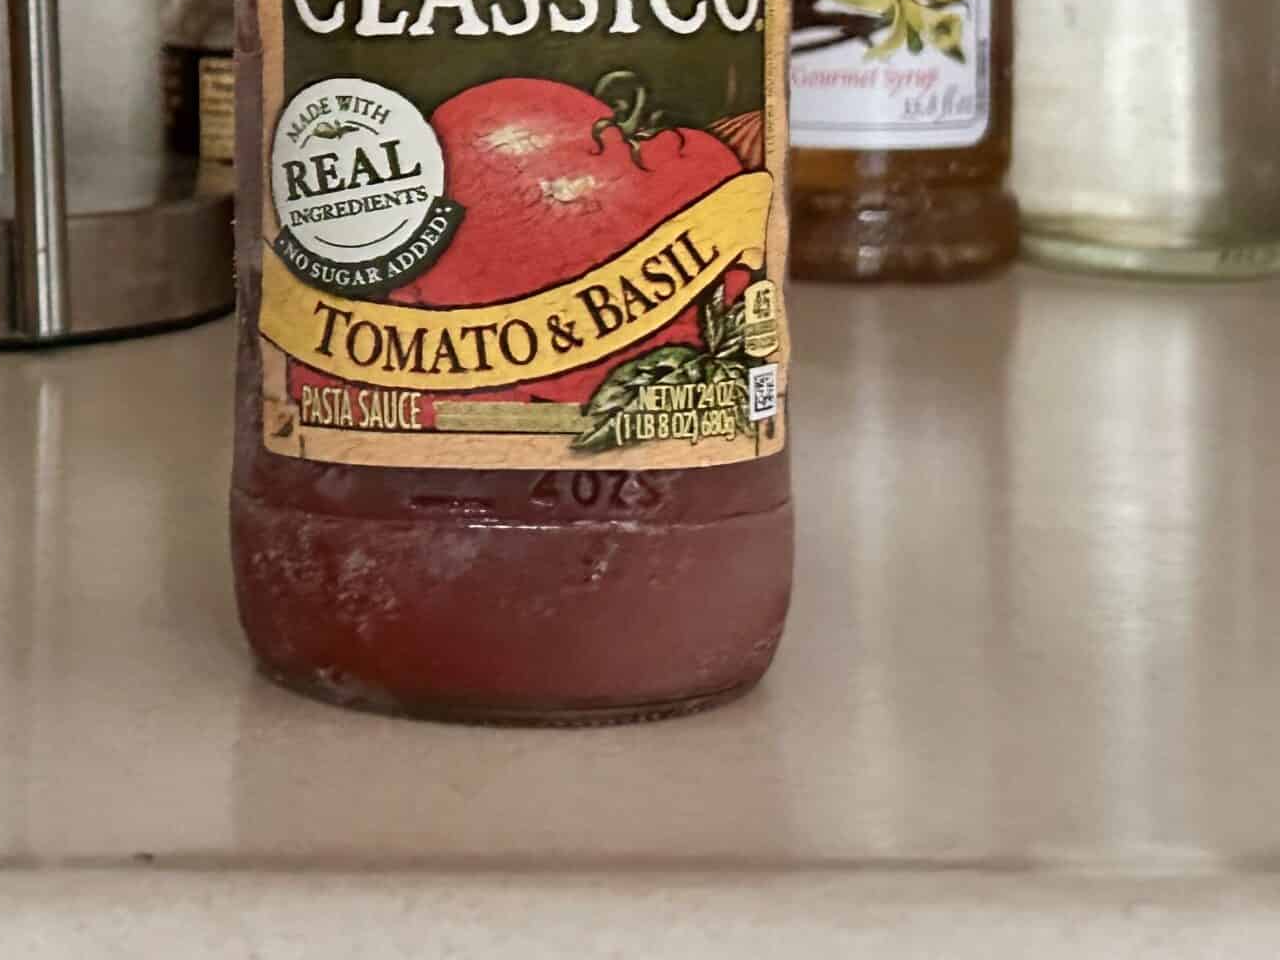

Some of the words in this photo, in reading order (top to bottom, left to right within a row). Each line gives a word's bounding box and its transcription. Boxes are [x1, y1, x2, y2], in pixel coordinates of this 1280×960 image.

[287, 97, 332, 143] MADE
[336, 95, 392, 125] WITH
[282, 139, 422, 201] REAL
[289, 185, 429, 227] INGREDIENTS
[284, 246, 309, 271] NO
[311, 262, 383, 286] SUGAR
[387, 215, 449, 278] ADDED
[313, 300, 538, 375] TOMATO
[549, 313, 584, 354] &
[577, 230, 720, 339] BASIL
[301, 385, 353, 426] PASTA
[358, 389, 422, 429] SAUCE
[639, 385, 668, 410] NET
[668, 383, 694, 409] WT
[697, 383, 716, 409] 24
[717, 380, 736, 407] OZ
[636, 413, 654, 439] LB
[657, 413, 669, 439] 8
[701, 407, 736, 440] 680g
